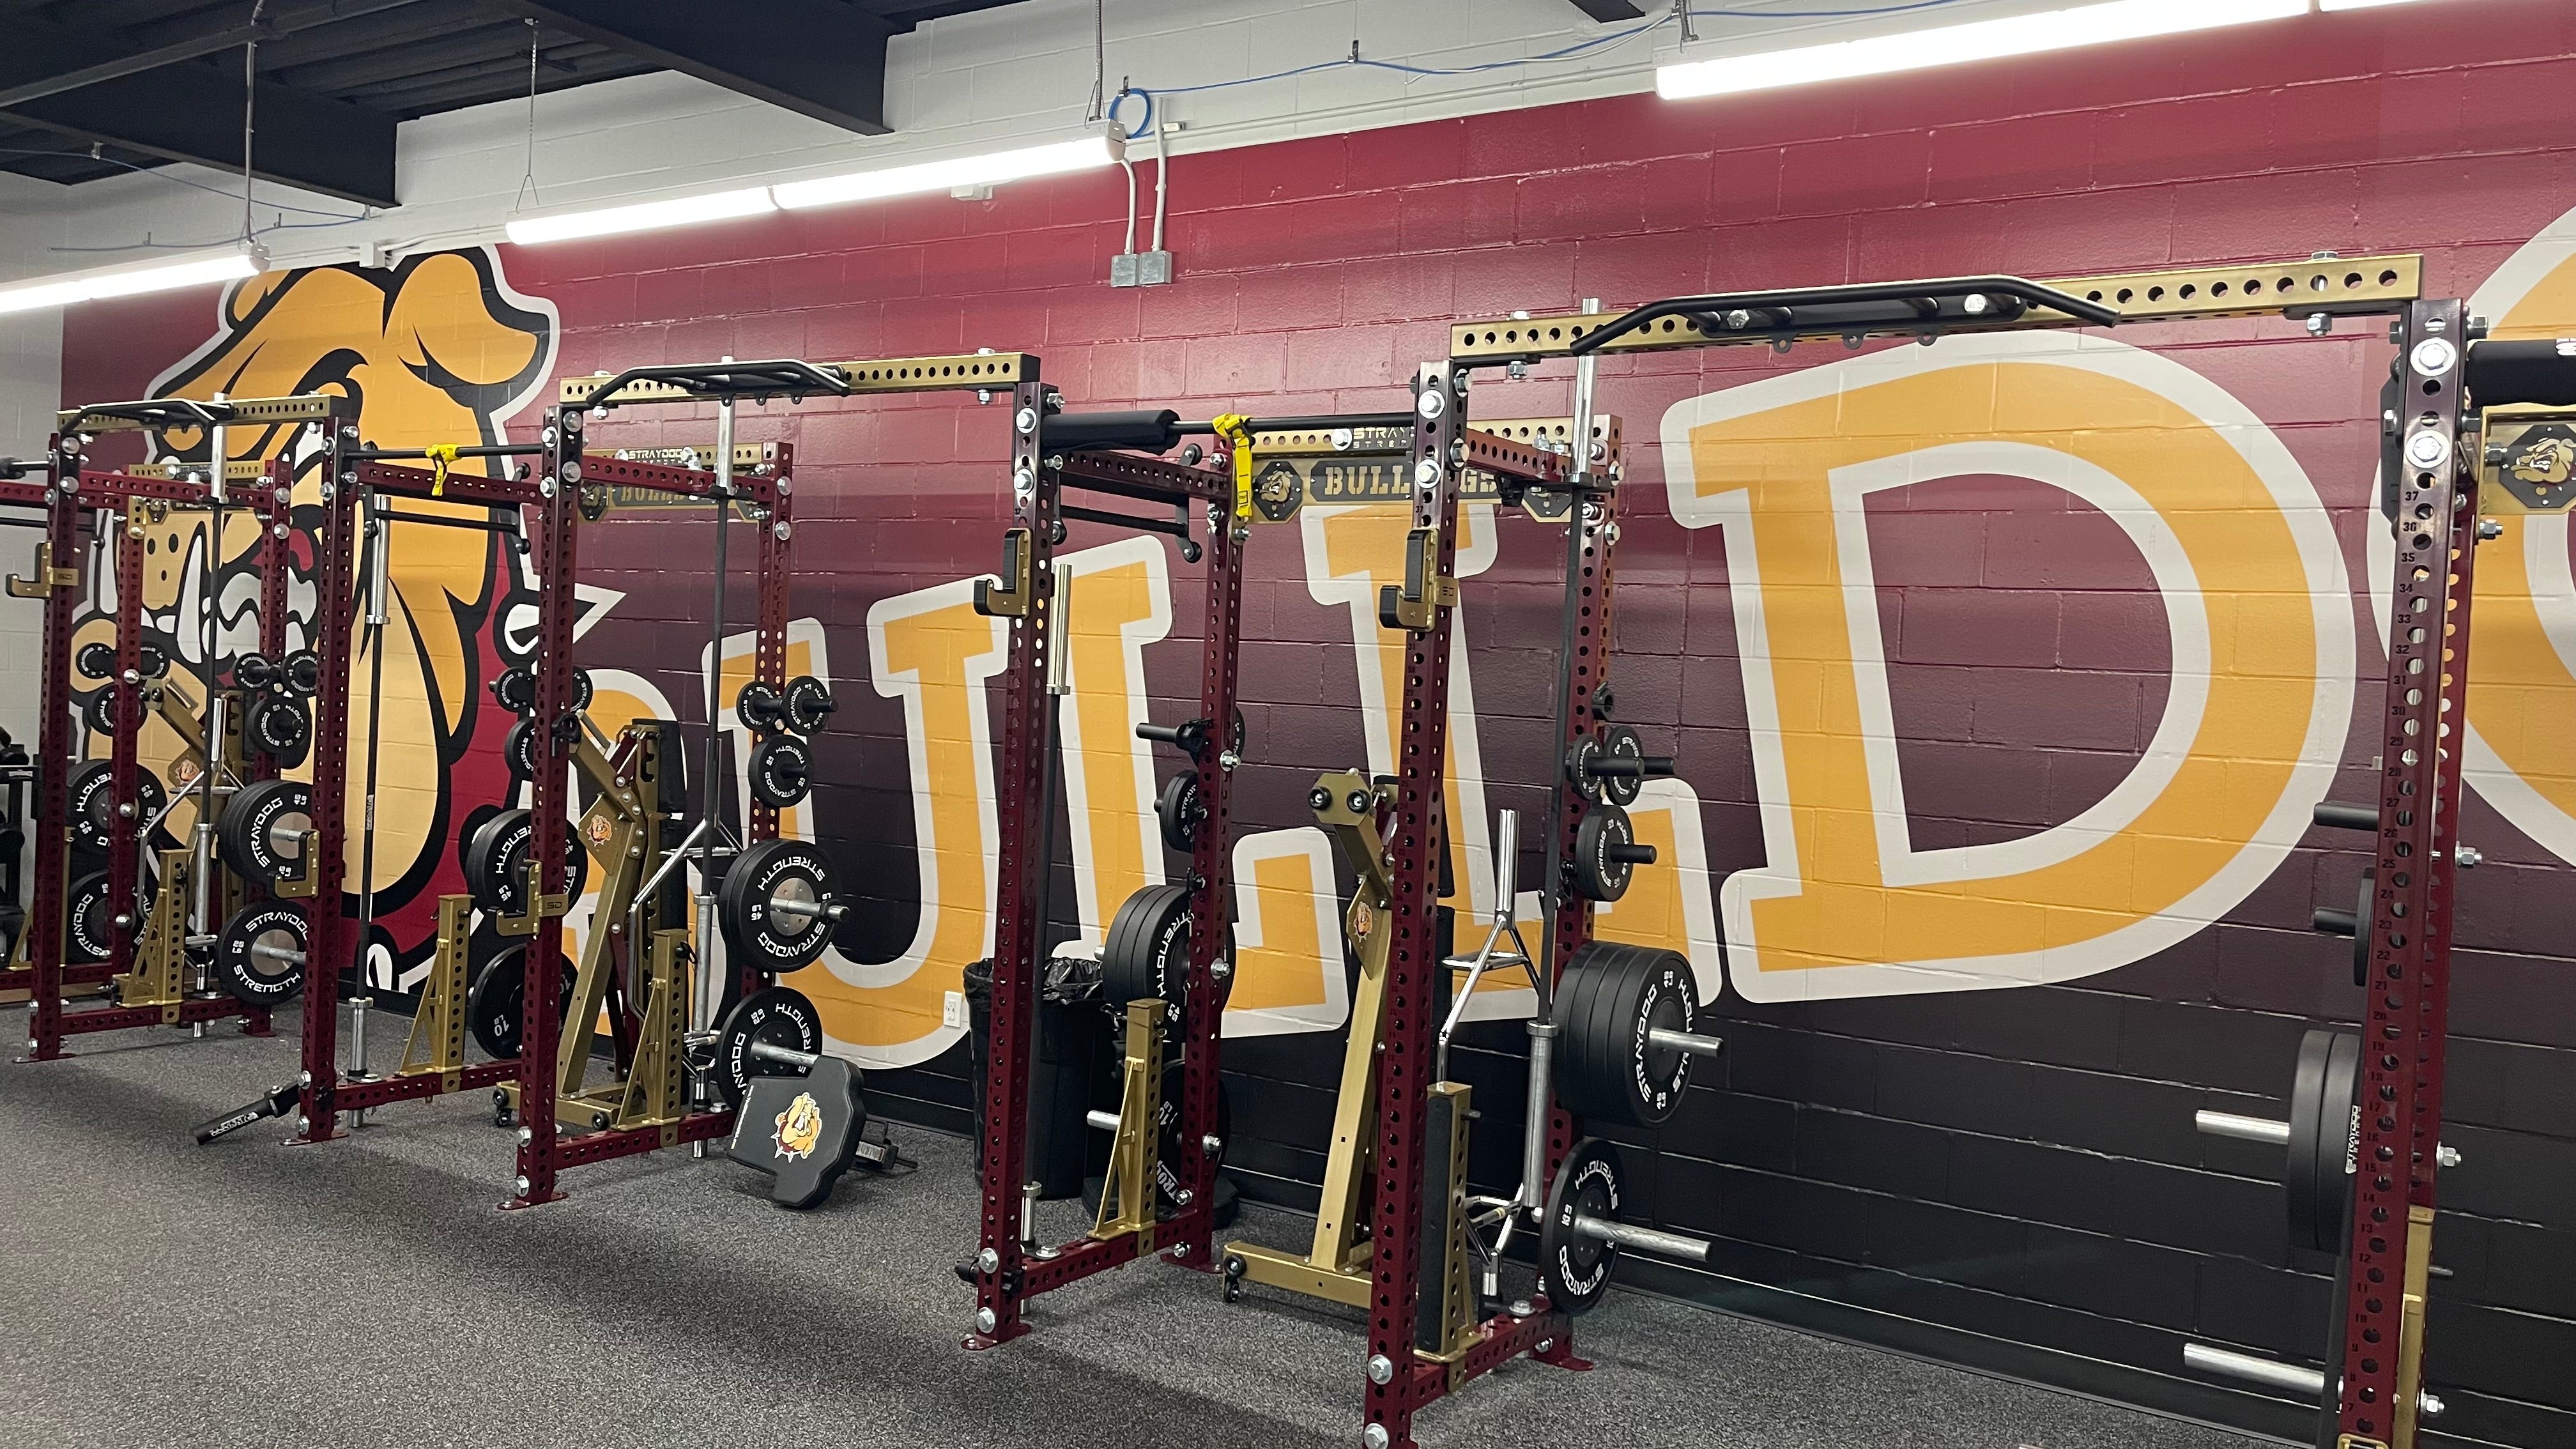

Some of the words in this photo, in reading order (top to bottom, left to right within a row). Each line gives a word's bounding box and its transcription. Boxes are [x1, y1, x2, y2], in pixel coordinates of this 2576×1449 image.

[1353, 426, 1405, 439] STRAY
[2405, 491, 2418, 501] 37
[2403, 522, 2416, 532] 36
[2402, 553, 2415, 562] 35
[2400, 583, 2413, 594] 34
[2397, 614, 2411, 624] 33
[2396, 645, 2409, 654] 32
[2394, 675, 2406, 685] 31
[790, 686, 802, 725] STRAYDOG
[775, 745, 805, 765] TRENGTH
[765, 771, 797, 798] STRAYDOG
[76, 772, 112, 812] ENGTH
[2386, 799, 2399, 808] 27
[250, 797, 283, 868] STRAYDOG
[2384, 829, 2398, 838] 26
[495, 825, 532, 874] ENGTH
[1598, 830, 1612, 887] STRAYDOG
[2382, 859, 2395, 868] 25
[757, 856, 825, 891] STRENGTH
[2380, 889, 2393, 899] 24
[546, 901, 563, 910] SD
[751, 913, 763, 921] 45
[73, 893, 103, 956] STRAYDOG
[2379, 920, 2392, 930] 23
[233, 940, 245, 948] 25
[757, 921, 825, 957] STRAYDOG
[1156, 912, 1190, 997] TRENGTH
[2377, 951, 2390, 960] 22
[233, 964, 301, 993] STRENGTH
[2375, 981, 2387, 990] 21
[1171, 1006, 1180, 1022] 45
[494, 1014, 504, 1025] LB
[494, 1020, 509, 1037] 10
[1635, 983, 1658, 1103] STRAYDOG
[2372, 1041, 2384, 1051] 19
[732, 1031, 747, 1095] AYDOG
[1163, 1101, 1173, 1113] LB
[2369, 1102, 2380, 1112] 17
[2367, 1132, 2379, 1142] 16
[2365, 1163, 2377, 1172] 15
[1575, 1160, 1618, 1210] STRENGTH
[2363, 1193, 2375, 1202] 14
[2361, 1223, 2373, 1233] 13
[2359, 1254, 2371, 1263] 12
[1559, 1245, 1604, 1296] STRAYDOG
[2358, 1283, 2368, 1293] 11
[2352, 1344, 2358, 1353] 9
[2347, 1402, 2354, 1411] 7
